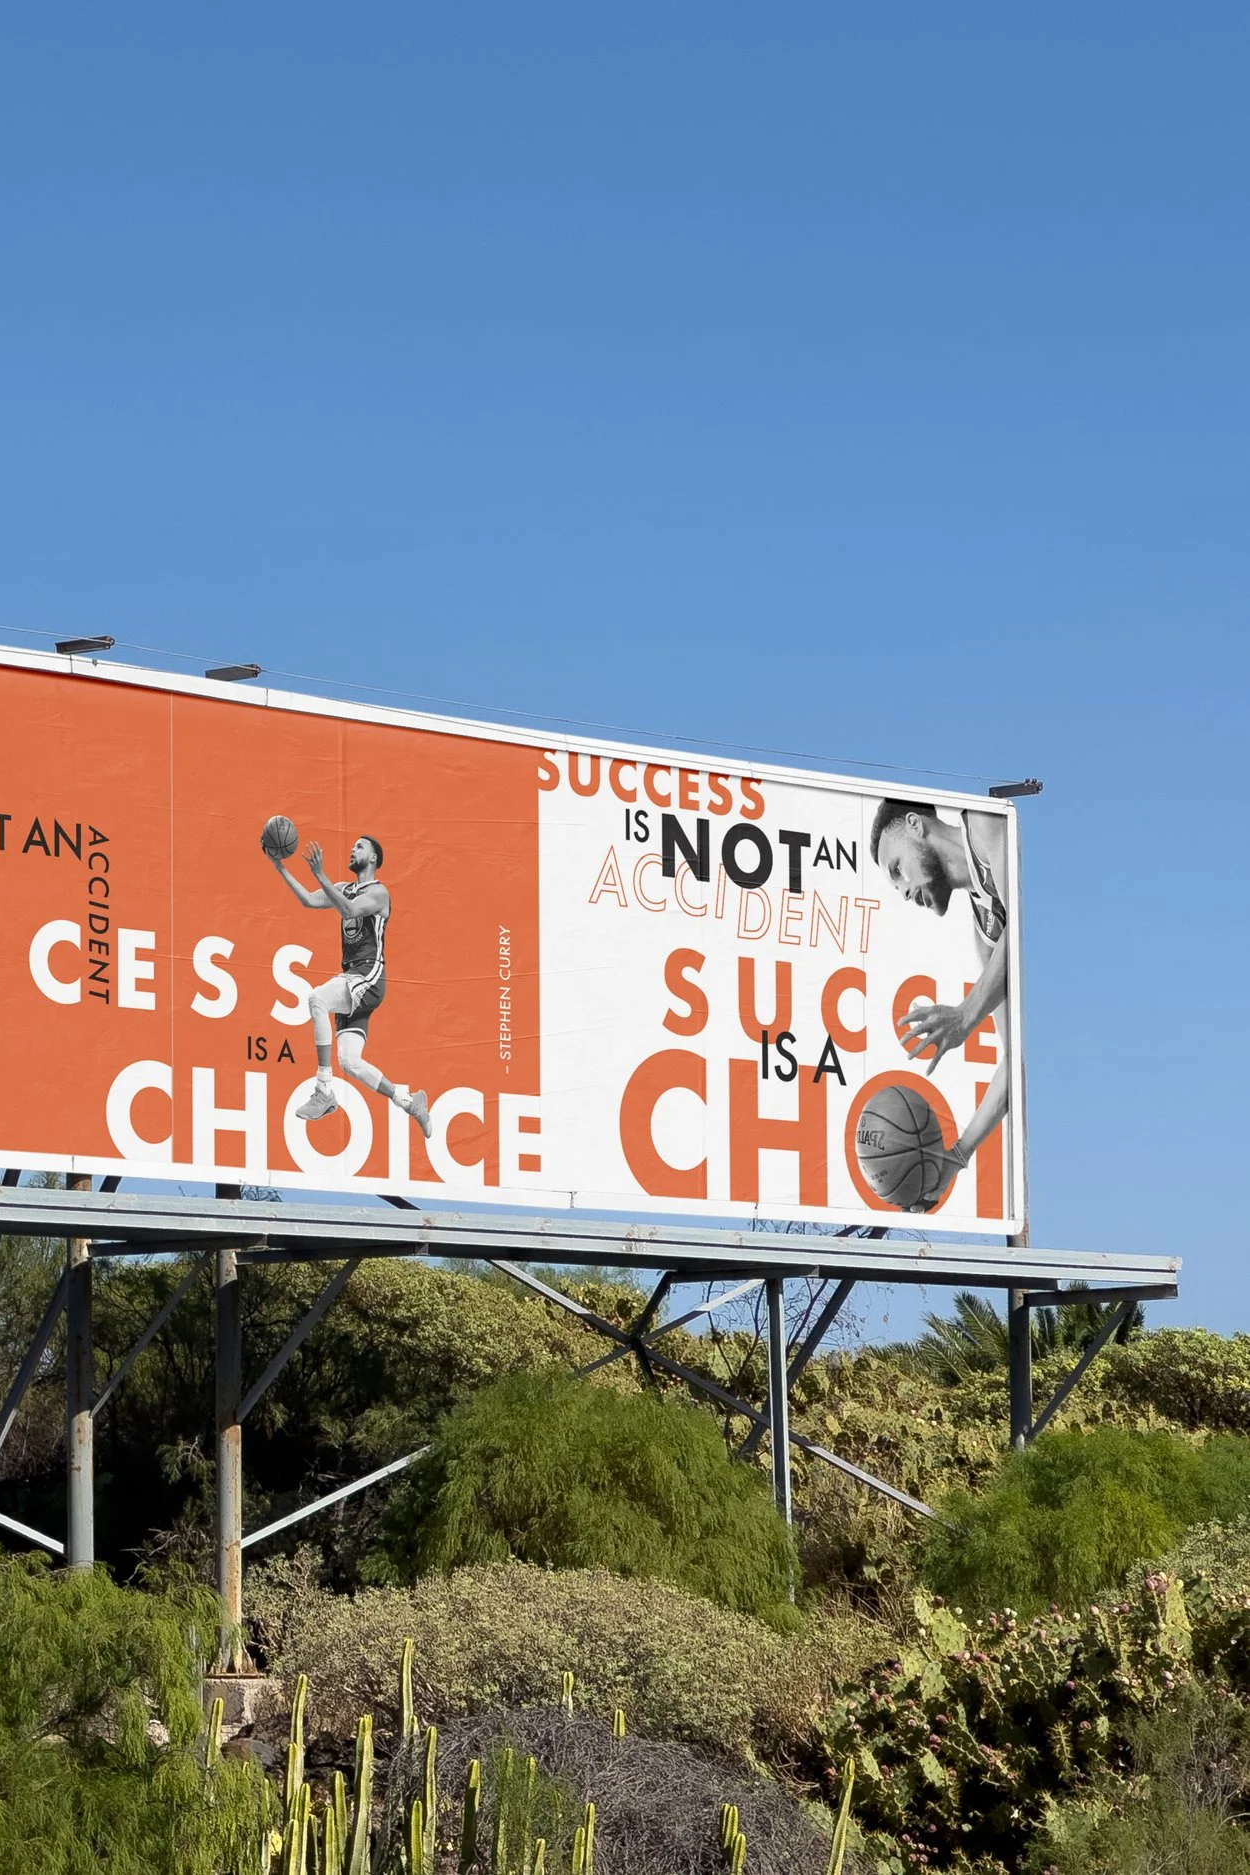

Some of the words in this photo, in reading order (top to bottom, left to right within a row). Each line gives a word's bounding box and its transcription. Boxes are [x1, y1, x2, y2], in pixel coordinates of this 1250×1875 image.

[537, 750, 766, 821] SUCCESS
[22, 816, 83, 861] AN
[625, 808, 650, 843] IS
[661, 813, 812, 894] NOT
[812, 835, 857, 874] AN
[88, 824, 111, 1005] ACCIDENT
[588, 844, 881, 954] ACCIDENT
[499, 925, 512, 981] CURRY
[247, 1036, 269, 1062] IS
[277, 1039, 296, 1064] A
[499, 986, 512, 1061] STEPHEN
[761, 1029, 799, 1083] IS
[812, 1033, 848, 1087] A
[106, 1060, 541, 1188] CHOICE
